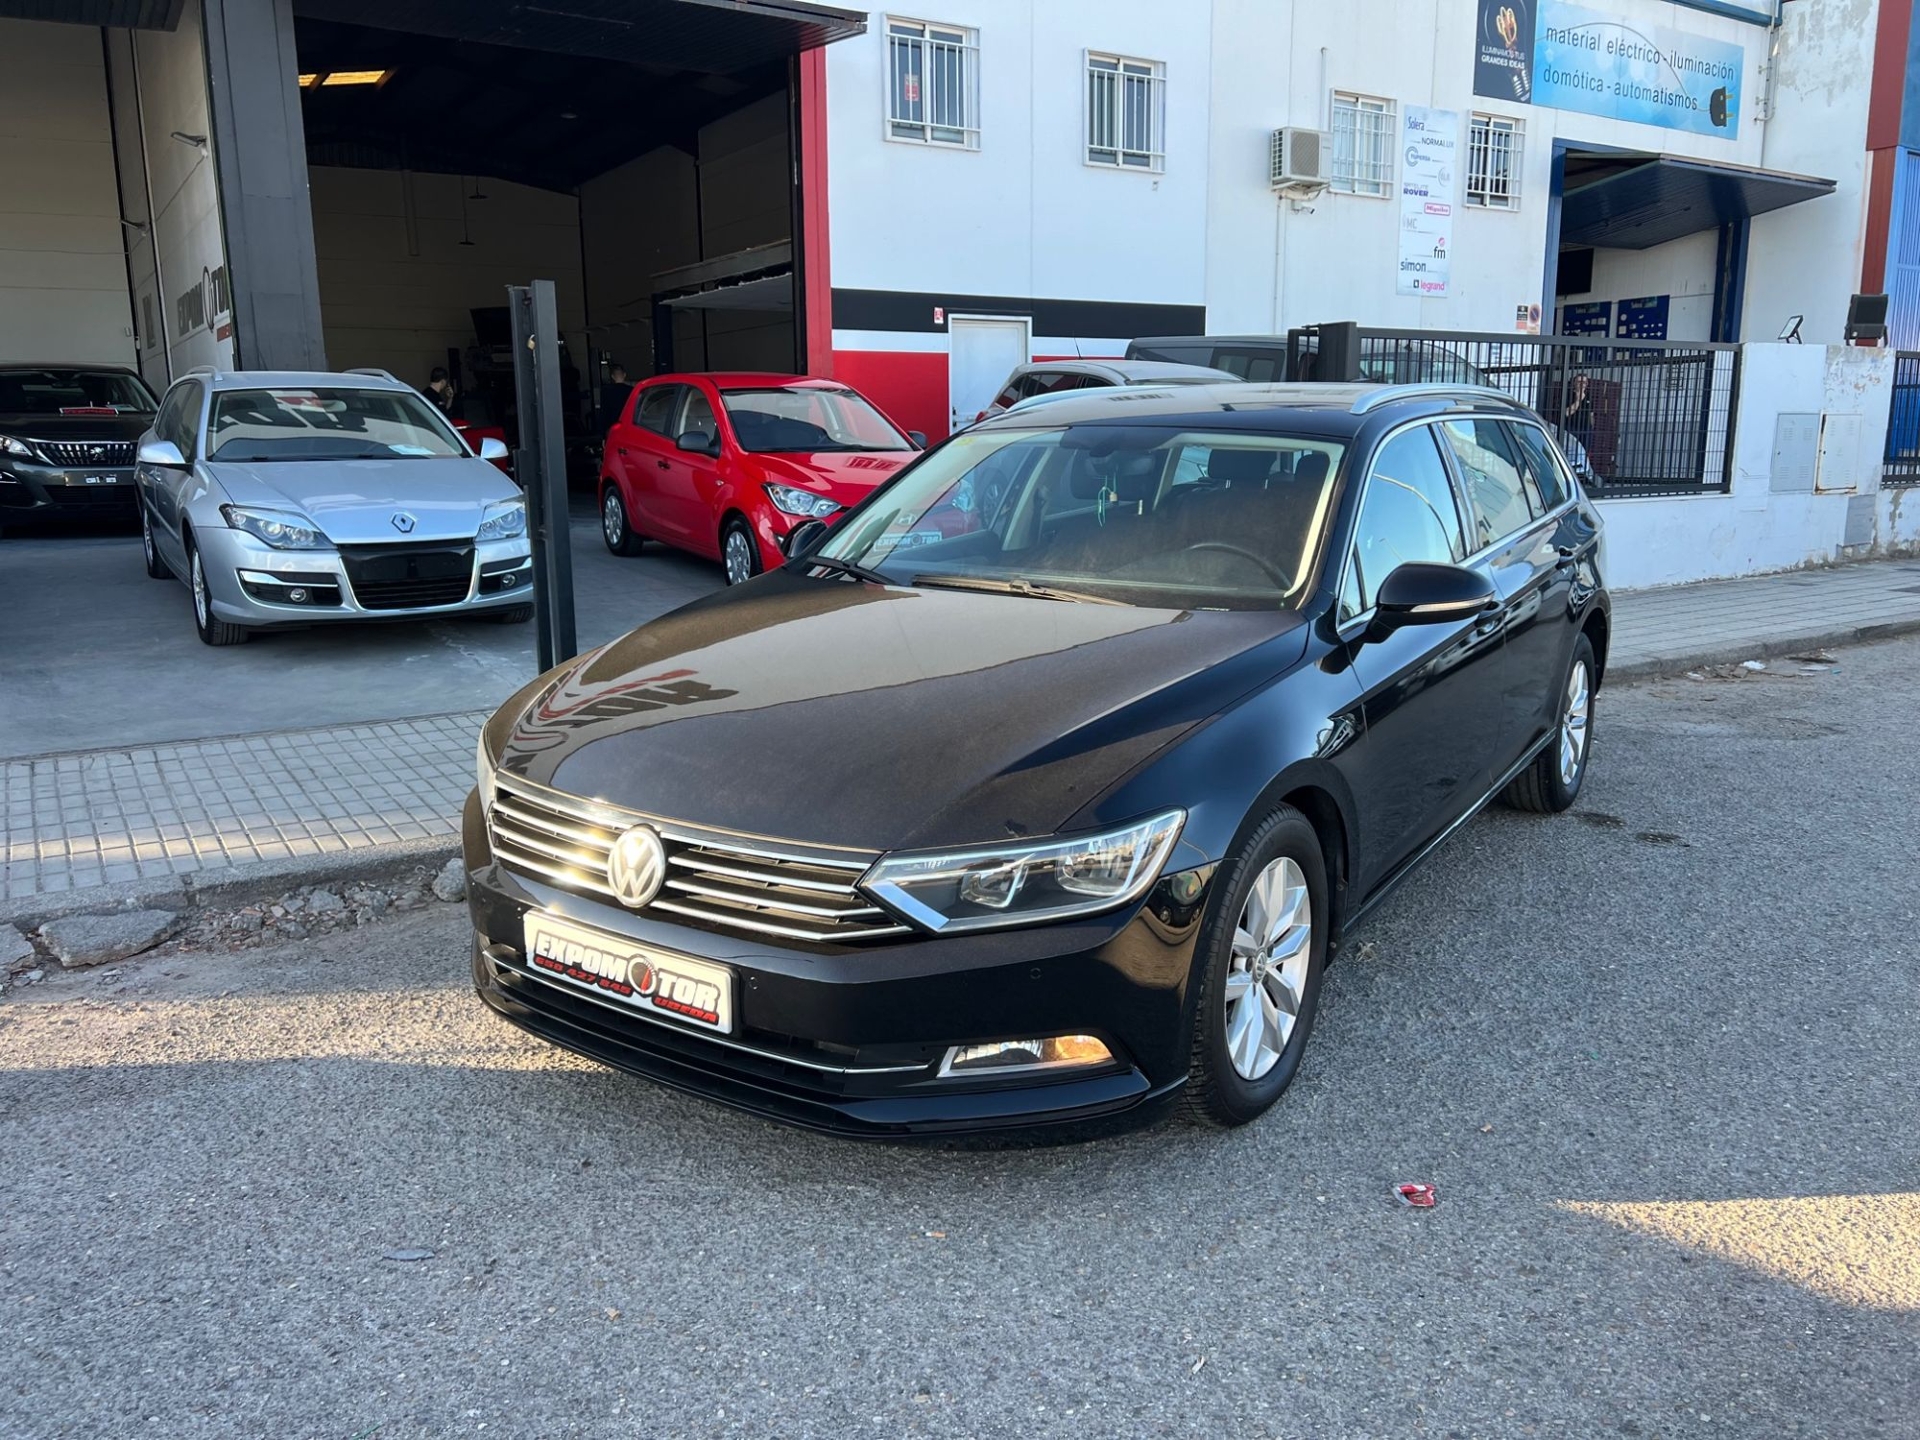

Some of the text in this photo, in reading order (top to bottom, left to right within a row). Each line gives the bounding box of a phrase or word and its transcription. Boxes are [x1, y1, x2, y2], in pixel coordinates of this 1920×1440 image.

[1482, 45, 1525, 60] ILUMINAMOS TUS
[1546, 26, 1601, 52] material
[1606, 38, 1661, 65] eléctrico
[1669, 50, 1735, 81] iluminación
[1481, 55, 1525, 69] GRANDES IDEAS
[1543, 65, 1603, 93] domótica
[1614, 82, 1699, 111] automatismos
[1408, 116, 1424, 131] Solera
[1421, 137, 1454, 148] NORMALUX
[1403, 188, 1429, 197] ROVER
[1433, 246, 1446, 259] fm
[1400, 258, 1427, 272] simon
[1421, 280, 1445, 292] legrand
[536, 931, 719, 1012] EXPOMOTOR
[567, 968, 596, 982] 427
